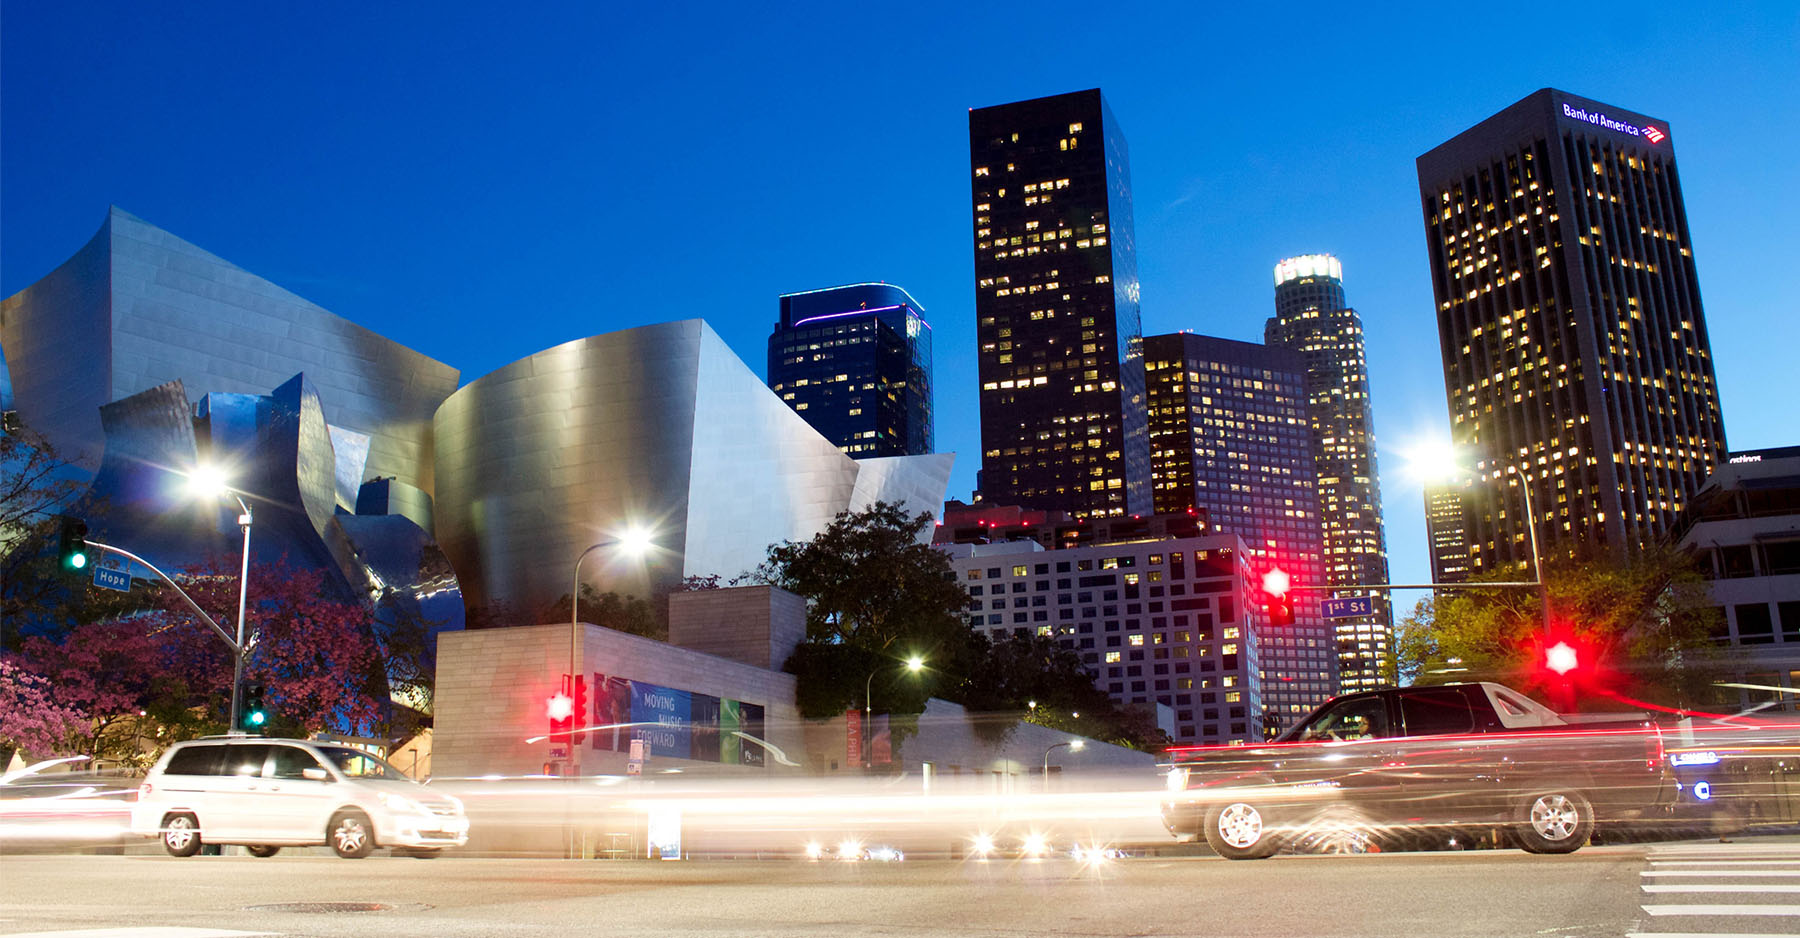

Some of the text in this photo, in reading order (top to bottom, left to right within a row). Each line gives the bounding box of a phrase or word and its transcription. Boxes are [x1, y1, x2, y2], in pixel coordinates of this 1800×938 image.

[1563, 103, 1640, 136] Bank of America
[100, 571, 125, 585] Hope
[1328, 601, 1365, 615] 1st St
[644, 692, 675, 711] MOVING
[659, 714, 682, 731] MUSIC
[637, 729, 675, 748] FORWARD
